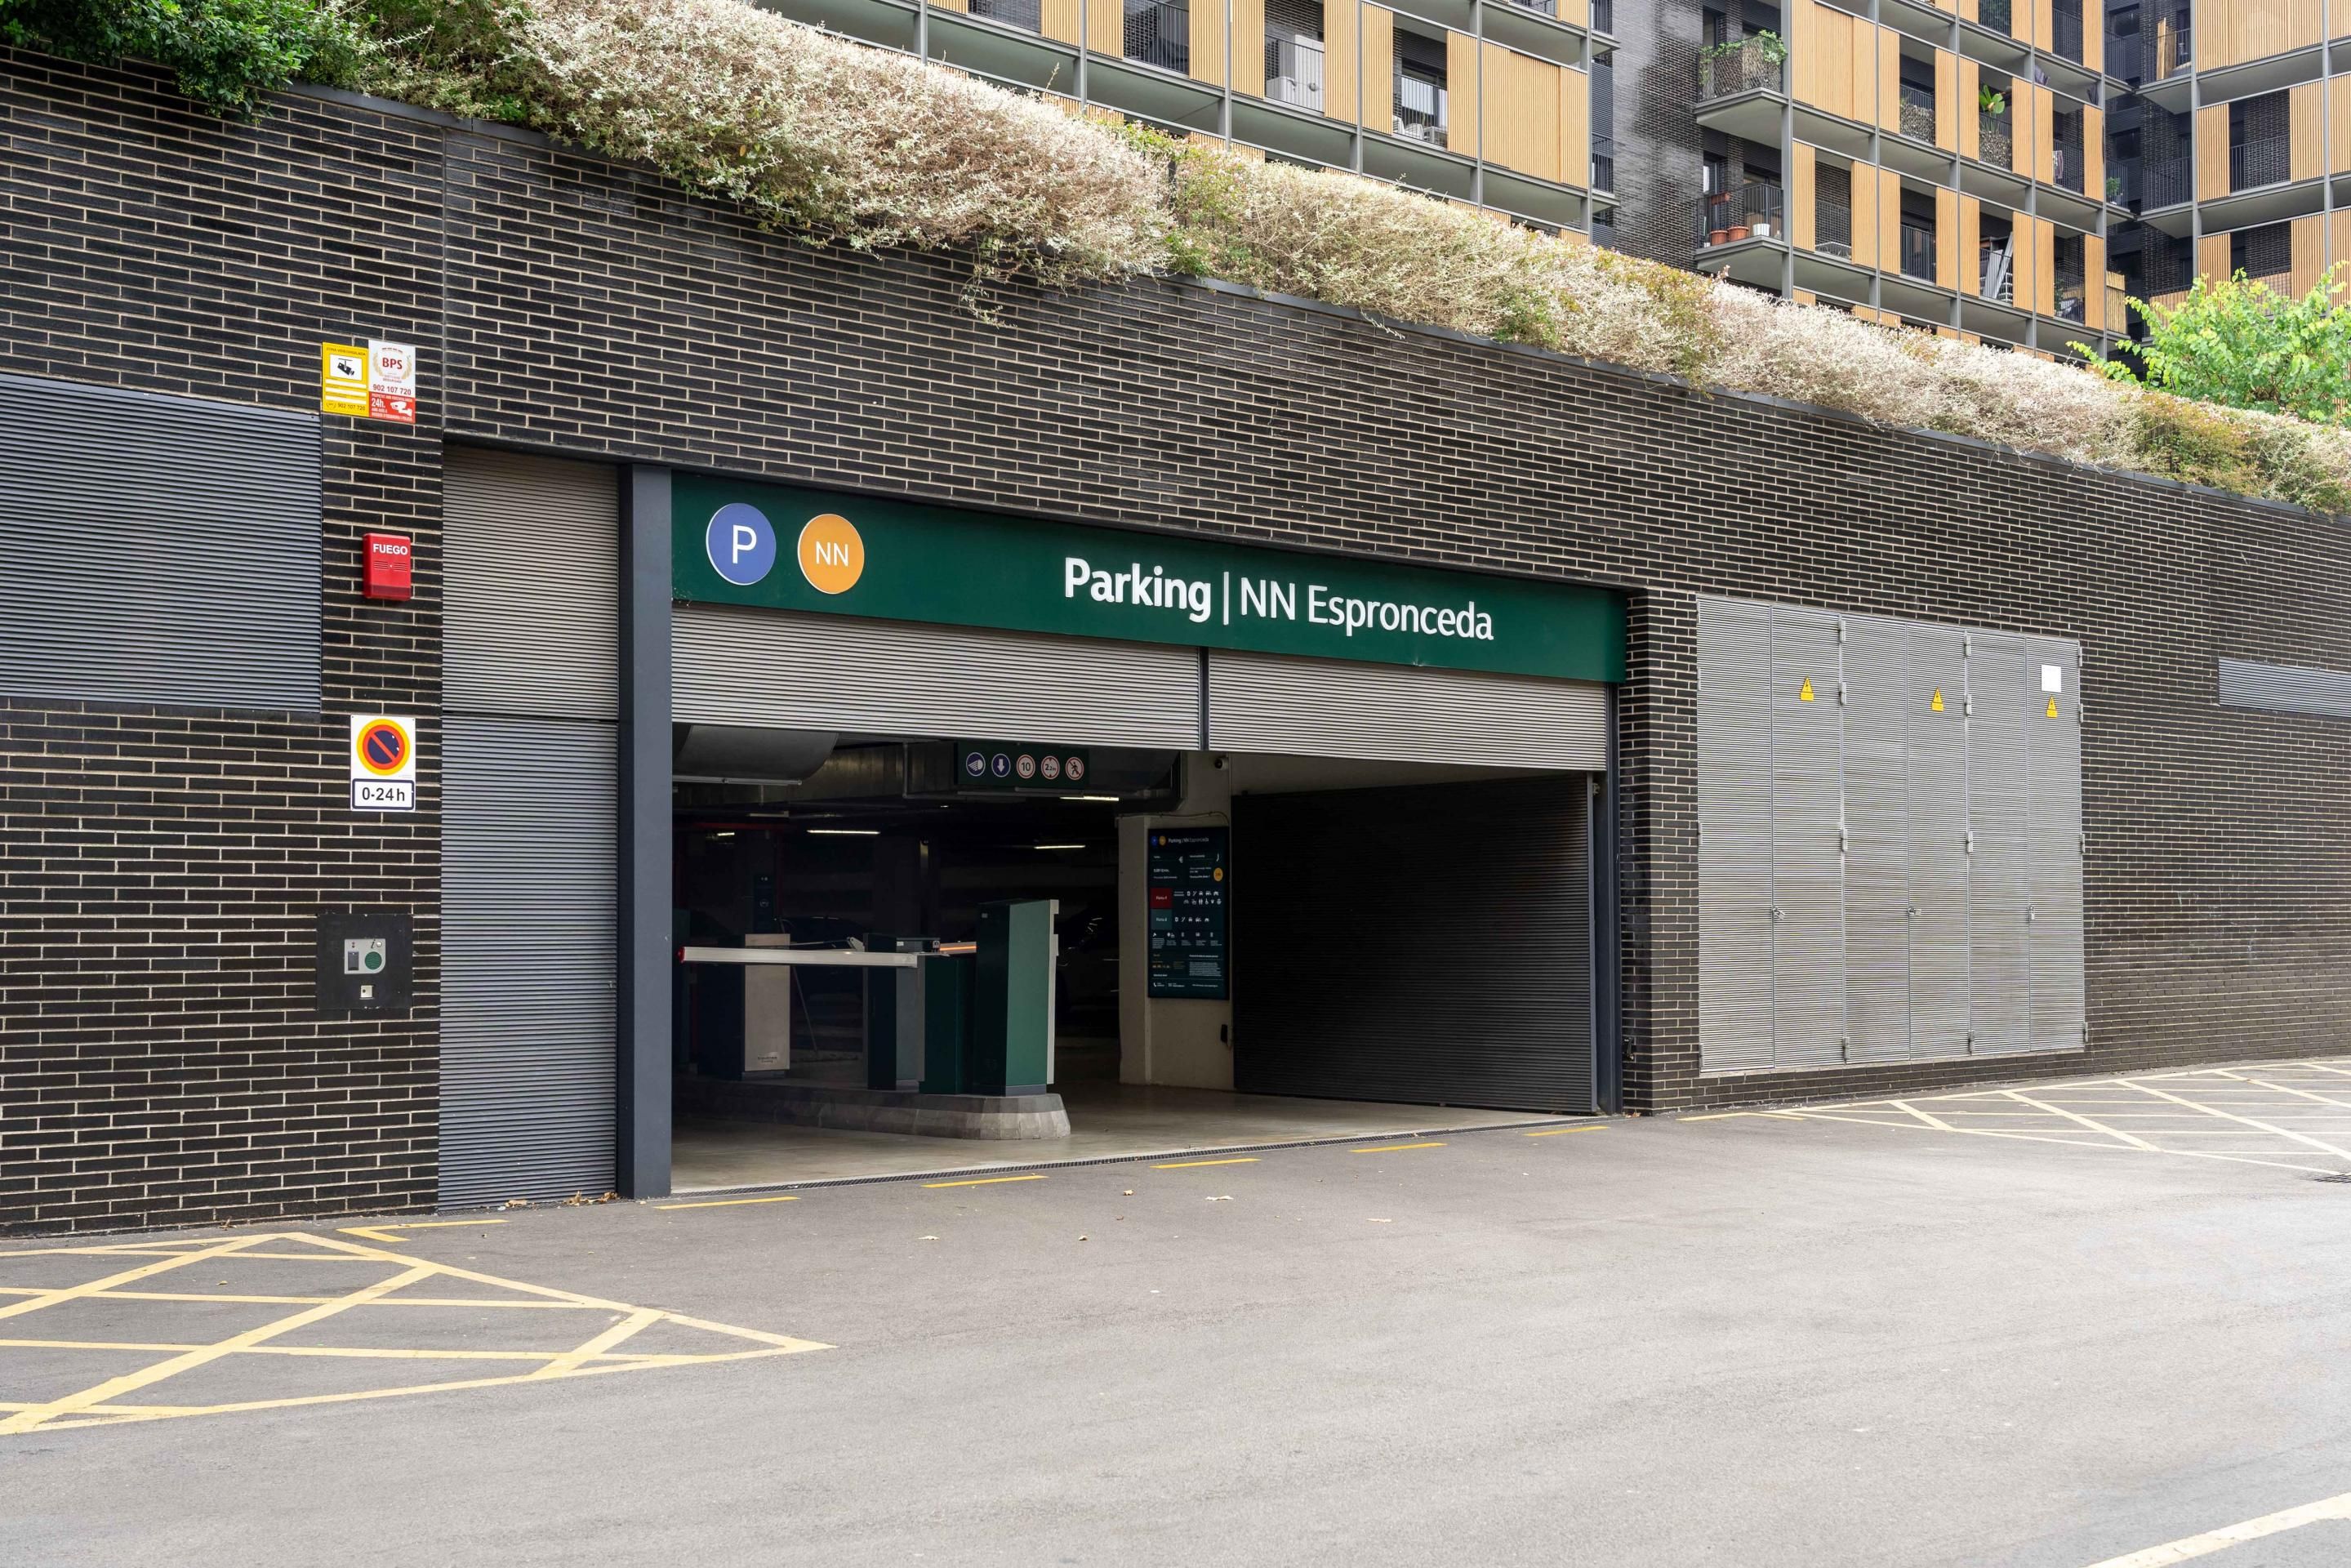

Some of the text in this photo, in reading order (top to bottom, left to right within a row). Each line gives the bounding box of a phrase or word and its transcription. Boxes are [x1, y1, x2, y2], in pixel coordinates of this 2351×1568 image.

[382, 357, 403, 370] BPS
[399, 387, 412, 395] 720
[373, 543, 408, 555] FUEGO
[732, 524, 757, 564] P
[816, 541, 848, 567] NN
[1064, 557, 1211, 623] Parking
[1240, 577, 1296, 620] NN
[1308, 585, 1494, 640] Espronceda
[1022, 762, 1031, 771] 10
